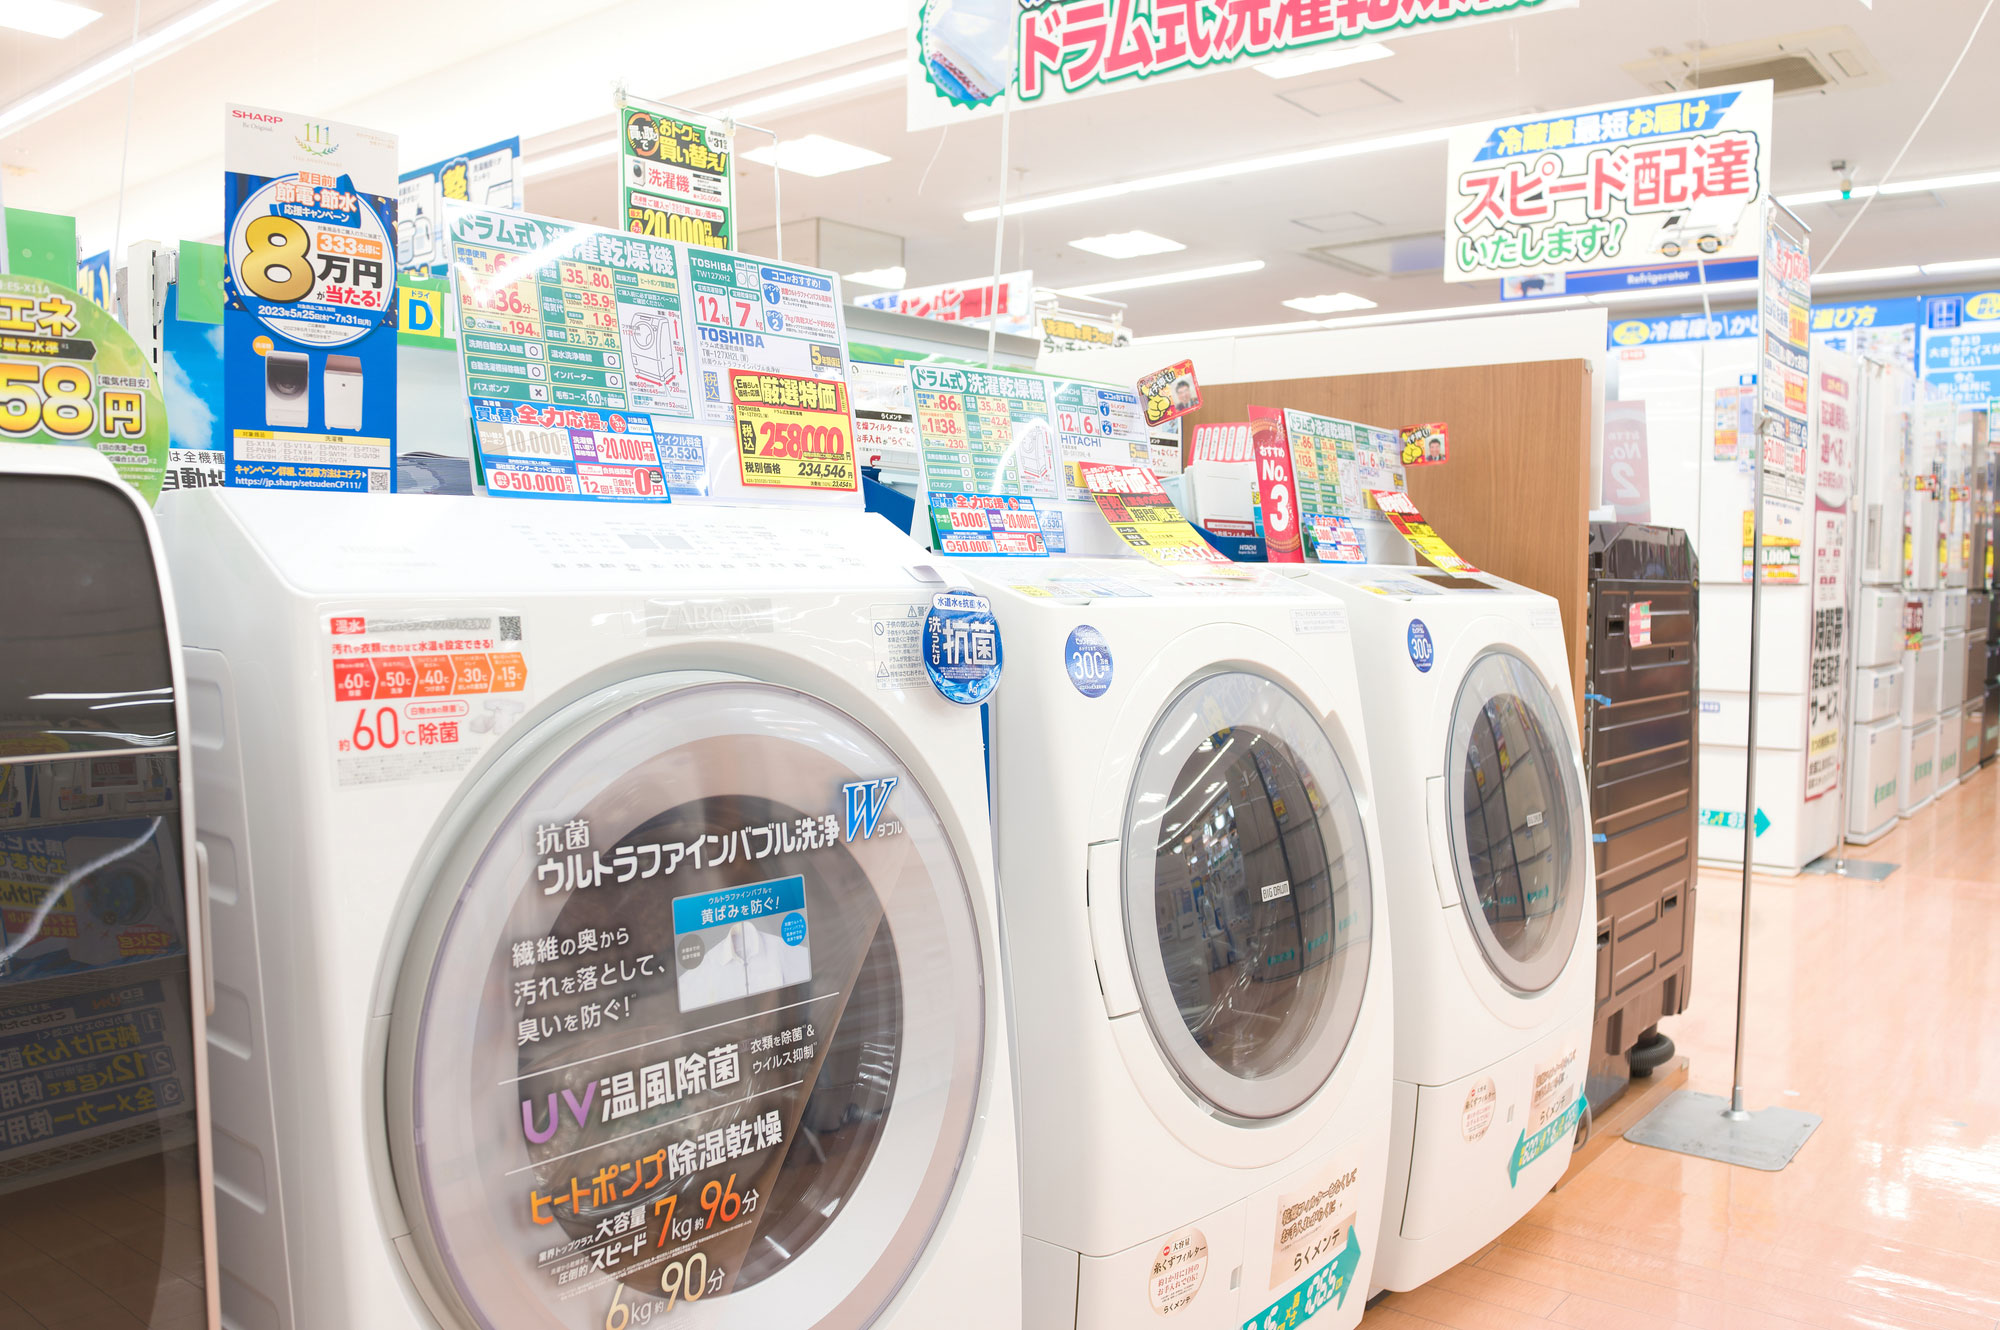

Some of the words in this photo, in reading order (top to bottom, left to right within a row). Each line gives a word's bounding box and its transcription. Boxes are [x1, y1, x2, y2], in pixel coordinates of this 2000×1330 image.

[232, 109, 283, 124] SHARP
[1496, 99, 1711, 155] 冷蔵庫最短お届け
[304, 123, 331, 145] 111
[659, 118, 701, 142] おトクに
[660, 136, 728, 172] 買い替え!
[299, 171, 337, 187] 夏目前!
[648, 167, 690, 193] 洗濯機
[1463, 139, 1750, 225] スピード配達
[275, 182, 358, 212] 節電・節水
[284, 204, 350, 222] 応援キャンペーン
[320, 234, 381, 255] 333名様に
[459, 214, 537, 249] ドラム式
[1461, 223, 1624, 266] いたします!
[691, 257, 734, 273] TOSHIBA
[1627, 269, 1690, 285] Refrigerator
[771, 271, 822, 289] ココがおすすめ!
[316, 284, 381, 308] が当たる!
[412, 290, 430, 299] ドライ
[408, 298, 433, 331] D
[698, 295, 730, 325] 12kg
[1813, 305, 1877, 329] 選び方
[698, 326, 765, 349] TOSHIBA
[473, 382, 510, 394] バスポンプ
[553, 370, 594, 381] インバーター
[704, 372, 719, 401] 税込
[915, 369, 963, 390] ドラム式
[968, 373, 1045, 400] 洗濯乾燥機
[760, 375, 837, 412] 厳選特価
[476, 406, 520, 424] 買い替え
[881, 413, 902, 422] らくメンテ
[656, 434, 702, 447] サイクル料金
[742, 423, 755, 452] 税込
[1060, 435, 1101, 448] HITACHI
[1259, 445, 1285, 458] おすすめ
[745, 462, 781, 476] 税別価格
[798, 462, 853, 480] 234,546円
[1262, 459, 1288, 482] No.
[1269, 484, 1290, 532] 3
[334, 619, 362, 633] 温水
[331, 639, 494, 656] 汚れや衣類に合わせて水温を設定できる!
[928, 616, 941, 665] 洗うたび
[943, 619, 997, 666] 抗菌
[537, 820, 590, 856] 抗菌
[538, 814, 841, 896] ウルトラファインバブル洗浄
[842, 776, 899, 843] W
[878, 822, 903, 839] ダブル
[708, 888, 773, 906] ウルトラファインバブルで
[701, 896, 780, 926] 黄ばみを防ぐ!
[512, 928, 630, 969] 繊維の奥から
[513, 955, 666, 1008] 汚れを落として、
[517, 1000, 631, 1046] 臭いを防ぐ!
[522, 1043, 741, 1144] UV温風除菌
[530, 1109, 784, 1226] ヒートポンプ除湿乾燥
[538, 1233, 594, 1262] 業界トップクラス
[595, 1204, 647, 1242] 大容量
[558, 1264, 589, 1286] 圧倒的
[589, 1232, 648, 1272] スピード
[1153, 1246, 1206, 1275] 糸くずフィルター
[1294, 1229, 1341, 1272] らくメンテ
[1163, 1295, 1191, 1314] らくメンテ
